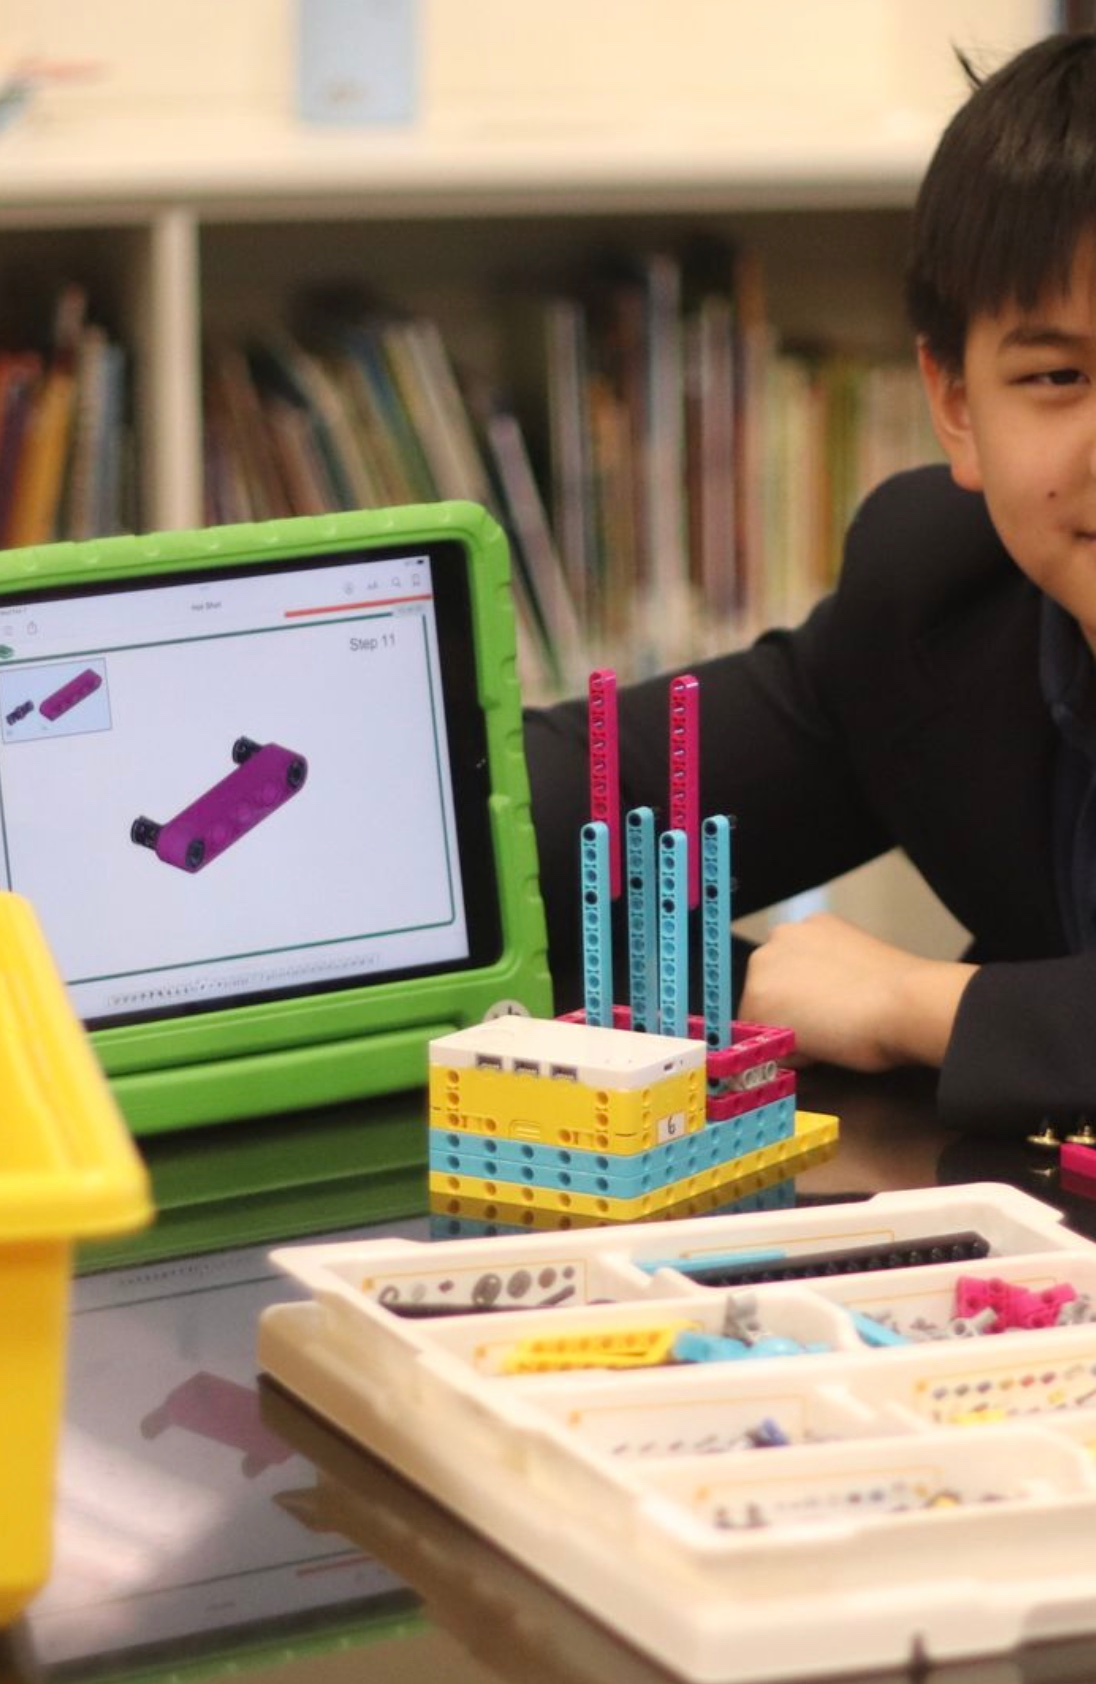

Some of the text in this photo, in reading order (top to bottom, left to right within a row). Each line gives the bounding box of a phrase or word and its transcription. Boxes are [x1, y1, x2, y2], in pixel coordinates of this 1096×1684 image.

[349, 633, 396, 652] Step 11
[667, 1115, 676, 1135] 6
